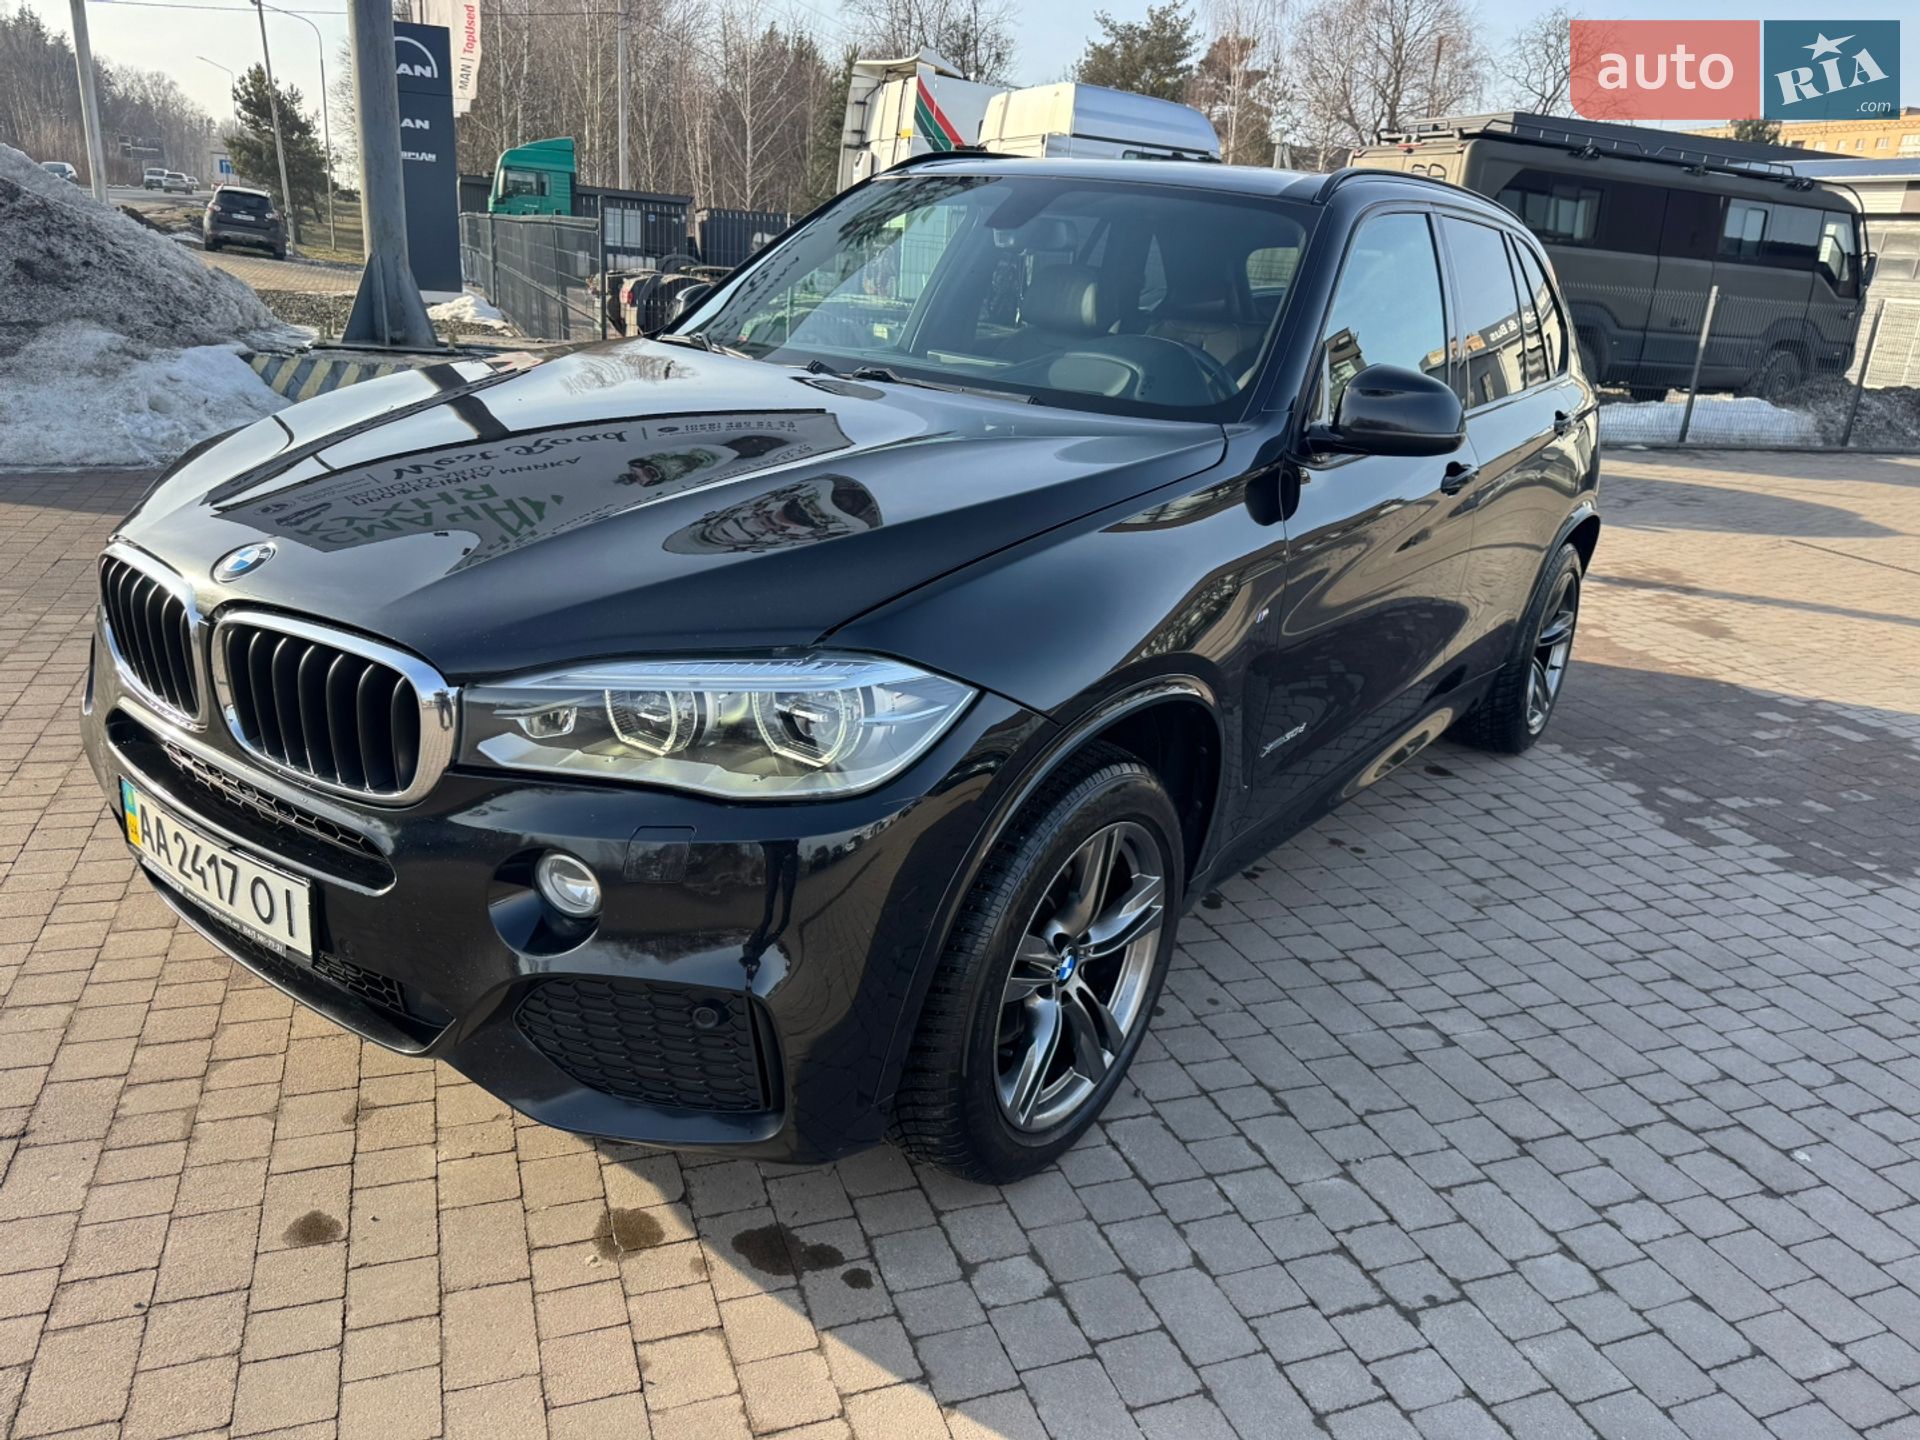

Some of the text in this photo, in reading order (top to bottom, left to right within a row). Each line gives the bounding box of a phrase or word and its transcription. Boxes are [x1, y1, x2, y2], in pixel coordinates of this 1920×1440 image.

[396, 62, 432, 78] AN
[458, 4, 478, 90] MAN TopUsed
[400, 118, 430, 130] AN
[140, 804, 173, 866] AA
[173, 831, 238, 906] 2417
